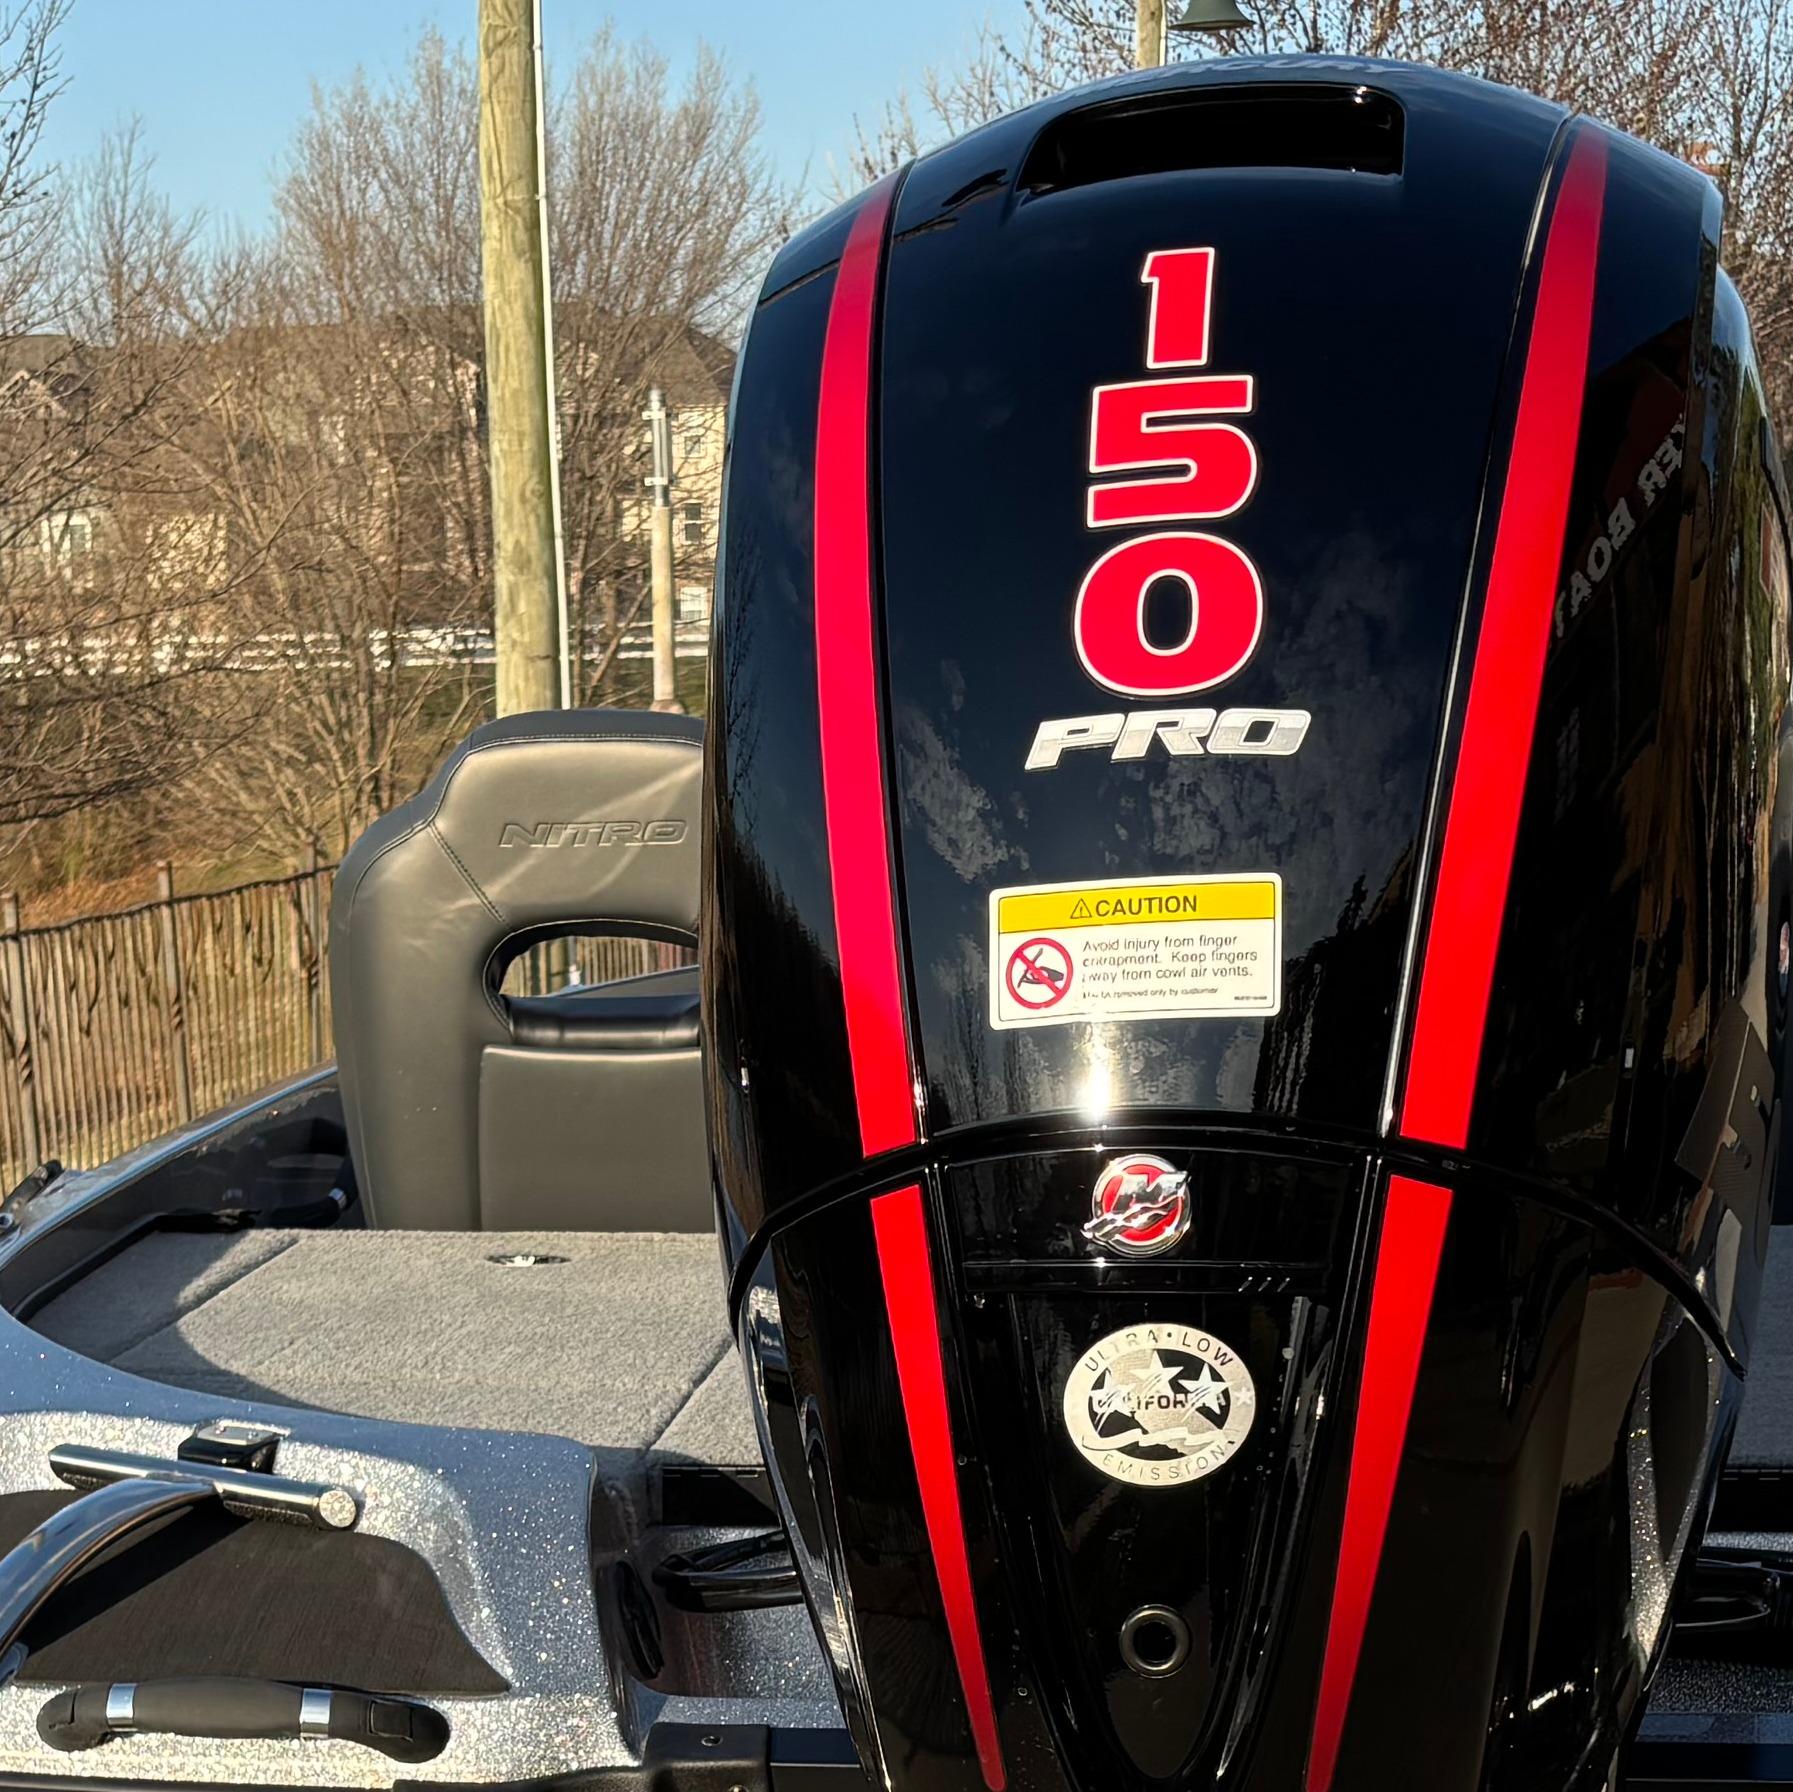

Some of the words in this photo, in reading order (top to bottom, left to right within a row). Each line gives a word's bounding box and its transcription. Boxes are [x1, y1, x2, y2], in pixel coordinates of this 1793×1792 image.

[1074, 247, 1263, 696] 150
[1024, 707, 1312, 770] PRO
[499, 820, 689, 848] NITRO
[1095, 895, 1198, 917] CAUTION
[1082, 939, 1119, 953] Avoid
[1123, 938, 1160, 952] injury
[1164, 936, 1194, 948] from
[1199, 935, 1238, 950] finger
[1171, 951, 1207, 965] Keep
[1211, 949, 1258, 964] fingers
[1122, 969, 1152, 981] from
[1155, 967, 1186, 979] cowl
[1190, 966, 1207, 978] air
[1211, 965, 1253, 977] vents.
[1085, 1329, 1159, 1372] ULRA
[1181, 1331, 1234, 1367] LOW
[1102, 1444, 1227, 1481] EMISSION
